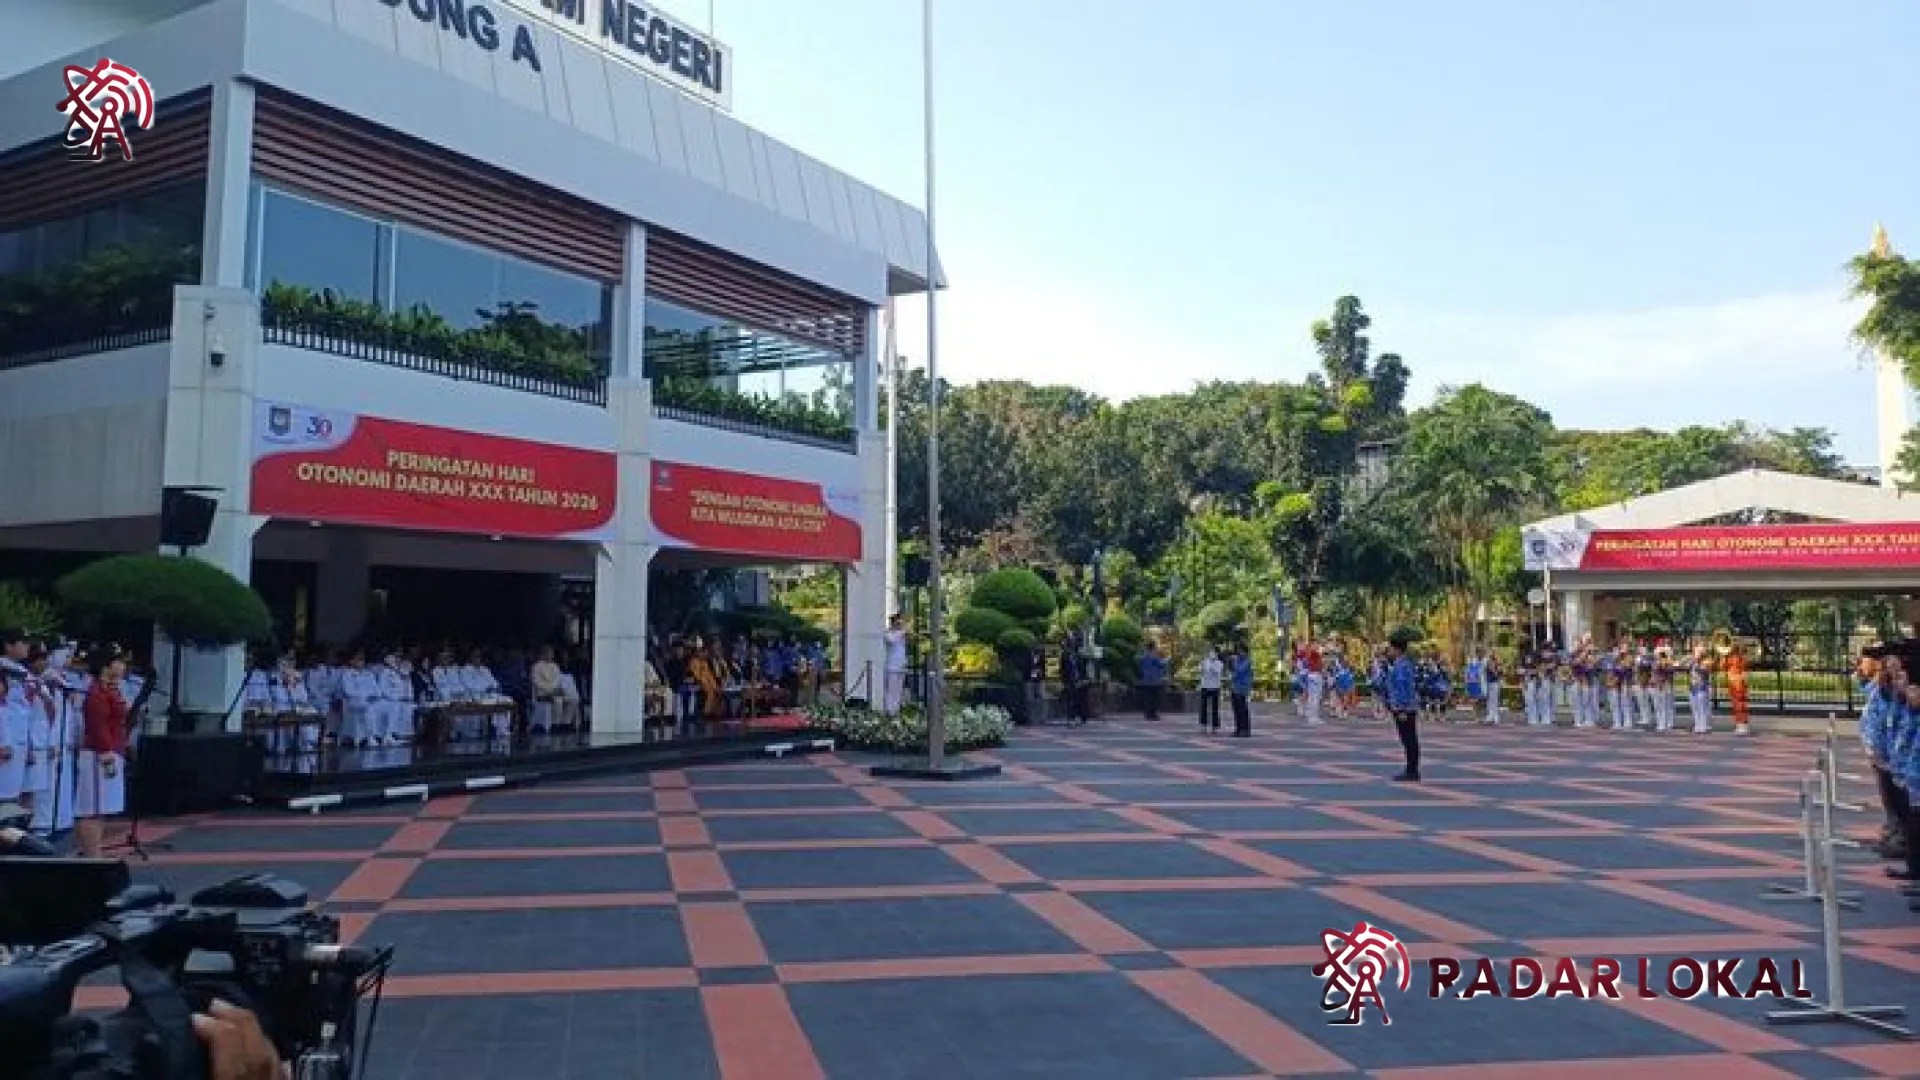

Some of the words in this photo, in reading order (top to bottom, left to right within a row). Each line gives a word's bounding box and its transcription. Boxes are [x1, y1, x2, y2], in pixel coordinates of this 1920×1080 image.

[379, 0, 500, 51] UNG
[512, 24, 542, 72] A
[601, 0, 723, 93] NEGERI
[298, 462, 390, 488] OTONOMI
[395, 473, 464, 496] DAERAH
[469, 482, 503, 500] XXX
[508, 484, 557, 504] TAHUN
[562, 492, 599, 511] 2026
[387, 451, 494, 478] PERINGATAN
[499, 456, 535, 483] HARI
